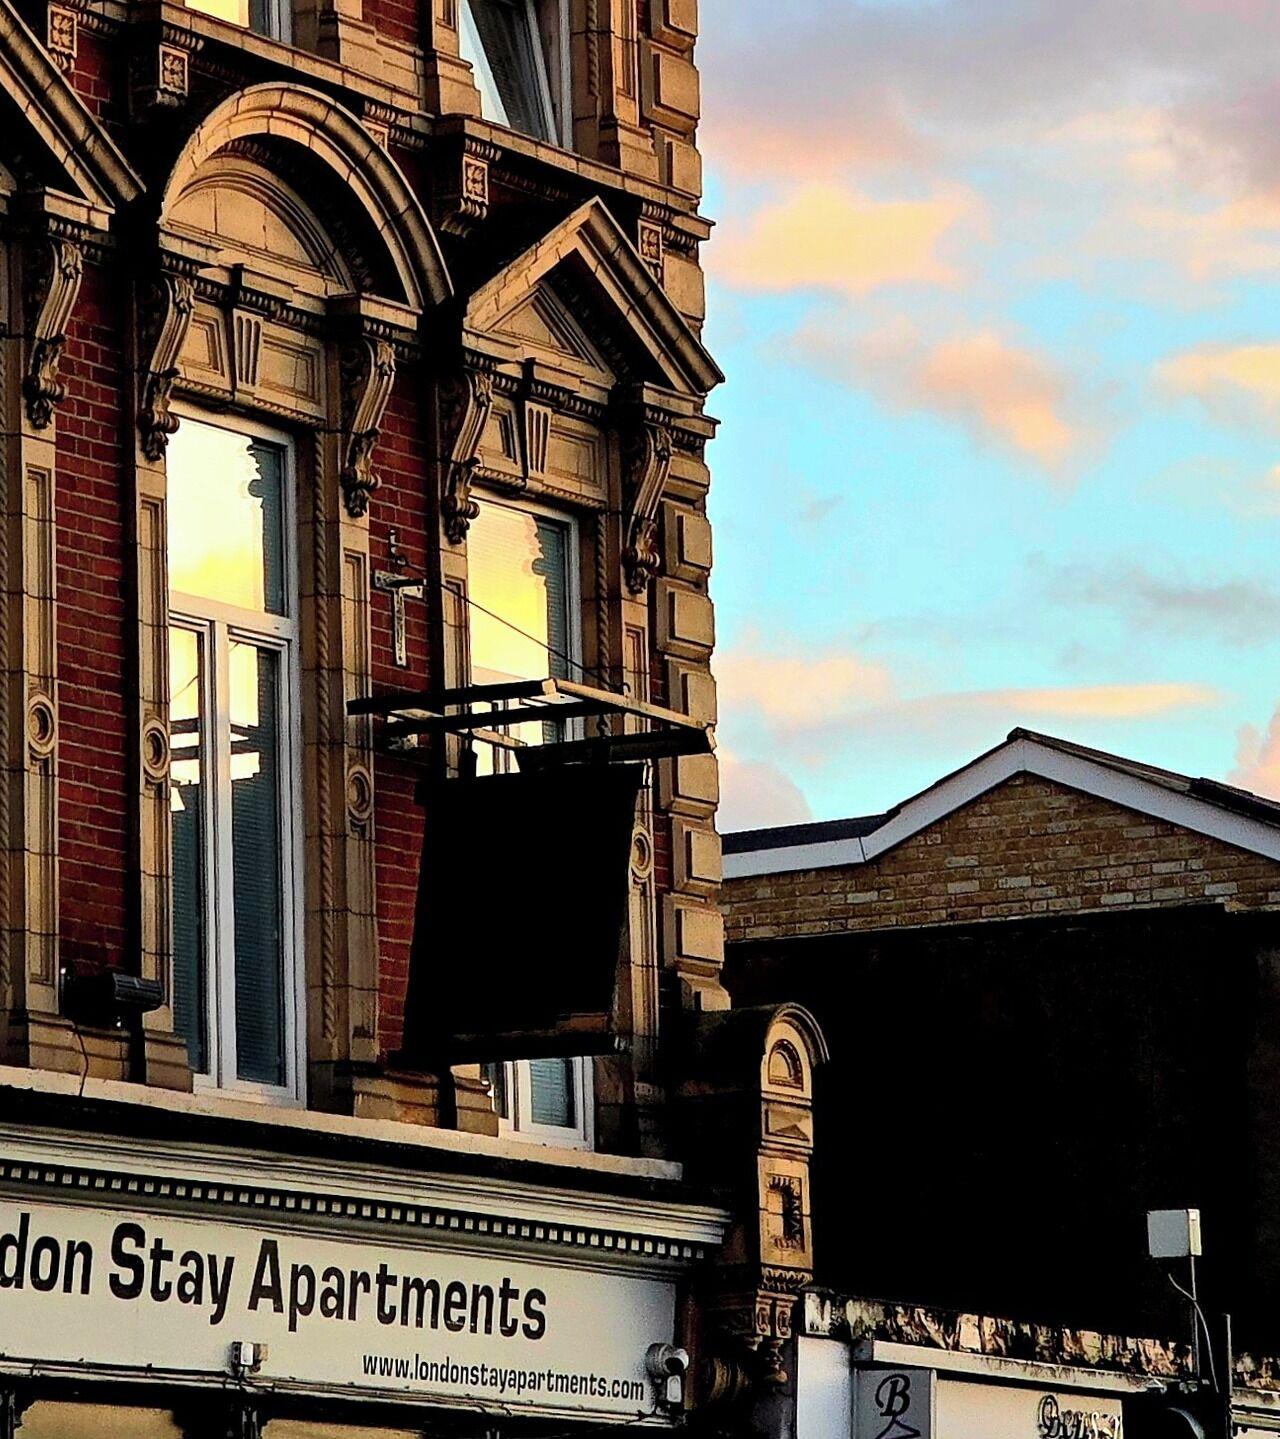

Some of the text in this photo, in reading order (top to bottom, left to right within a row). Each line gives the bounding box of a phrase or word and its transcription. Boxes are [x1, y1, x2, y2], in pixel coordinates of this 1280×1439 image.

[108, 1222, 235, 1326] Stay
[247, 1238, 548, 1341] Apartments
[363, 1353, 645, 1401] www.londonstayapartments.com
